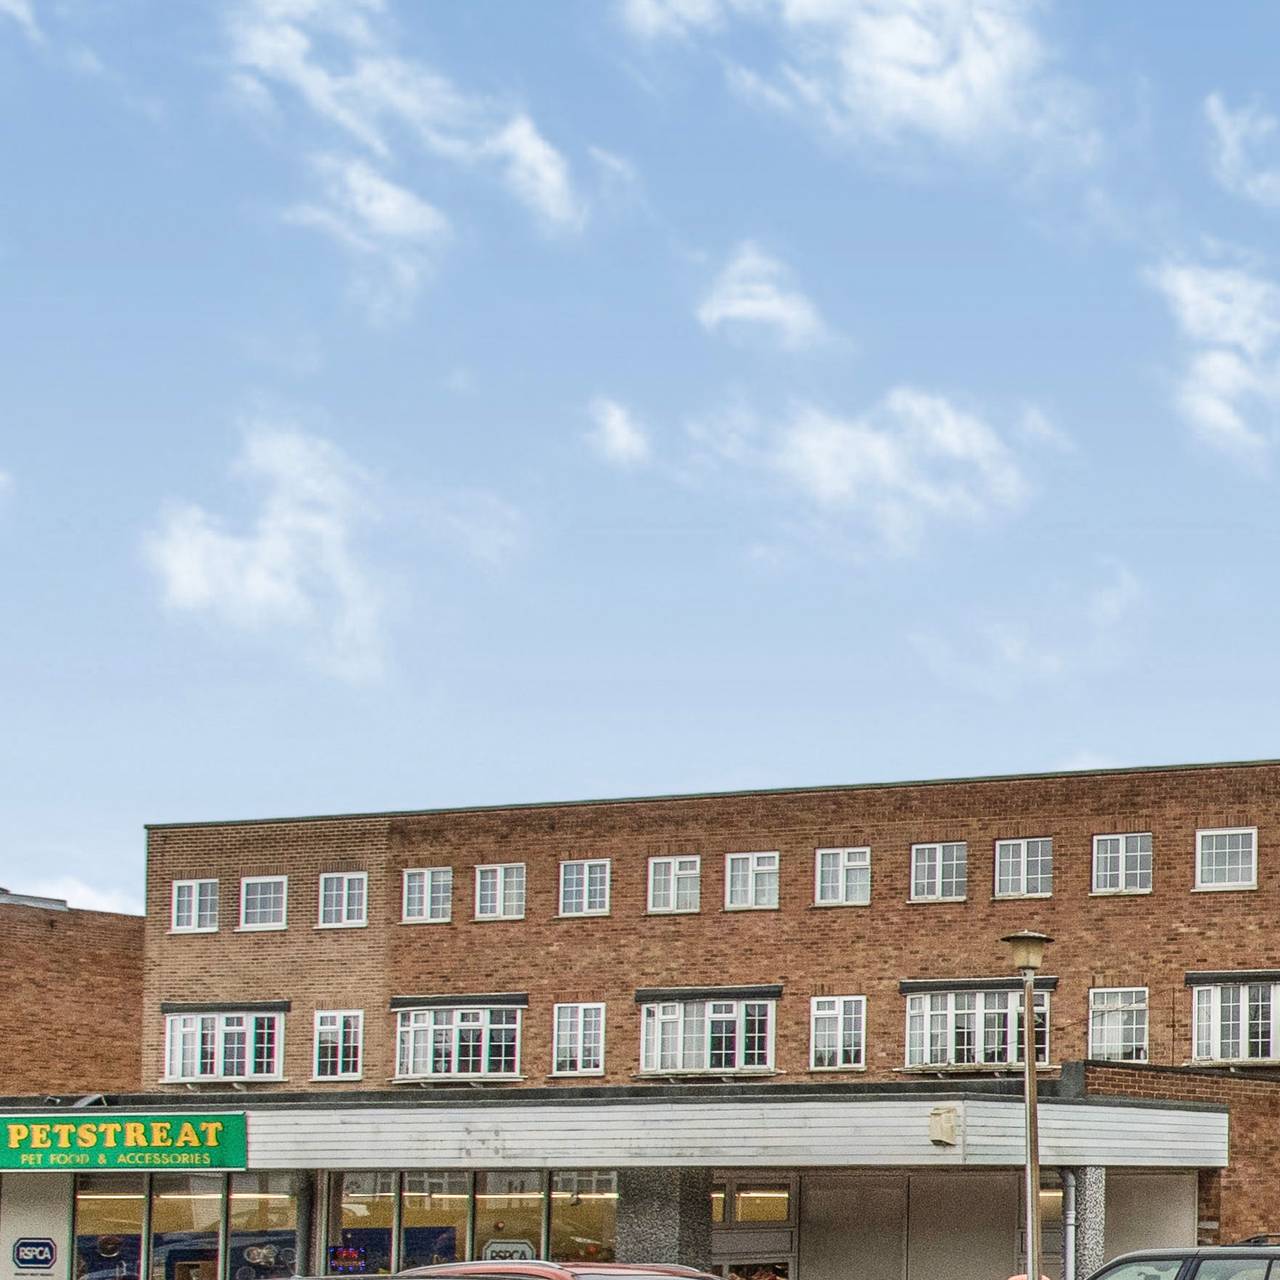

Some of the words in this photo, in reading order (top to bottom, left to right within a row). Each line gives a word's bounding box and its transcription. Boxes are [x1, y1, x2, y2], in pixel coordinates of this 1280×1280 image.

[7, 1121, 223, 1149] PETSTREAT
[21, 1154, 42, 1164] PET
[50, 1154, 89, 1164] FOOD
[98, 1154, 107, 1164] &
[117, 1153, 210, 1164] ACCESSORIES
[19, 1247, 51, 1260] RSPCA
